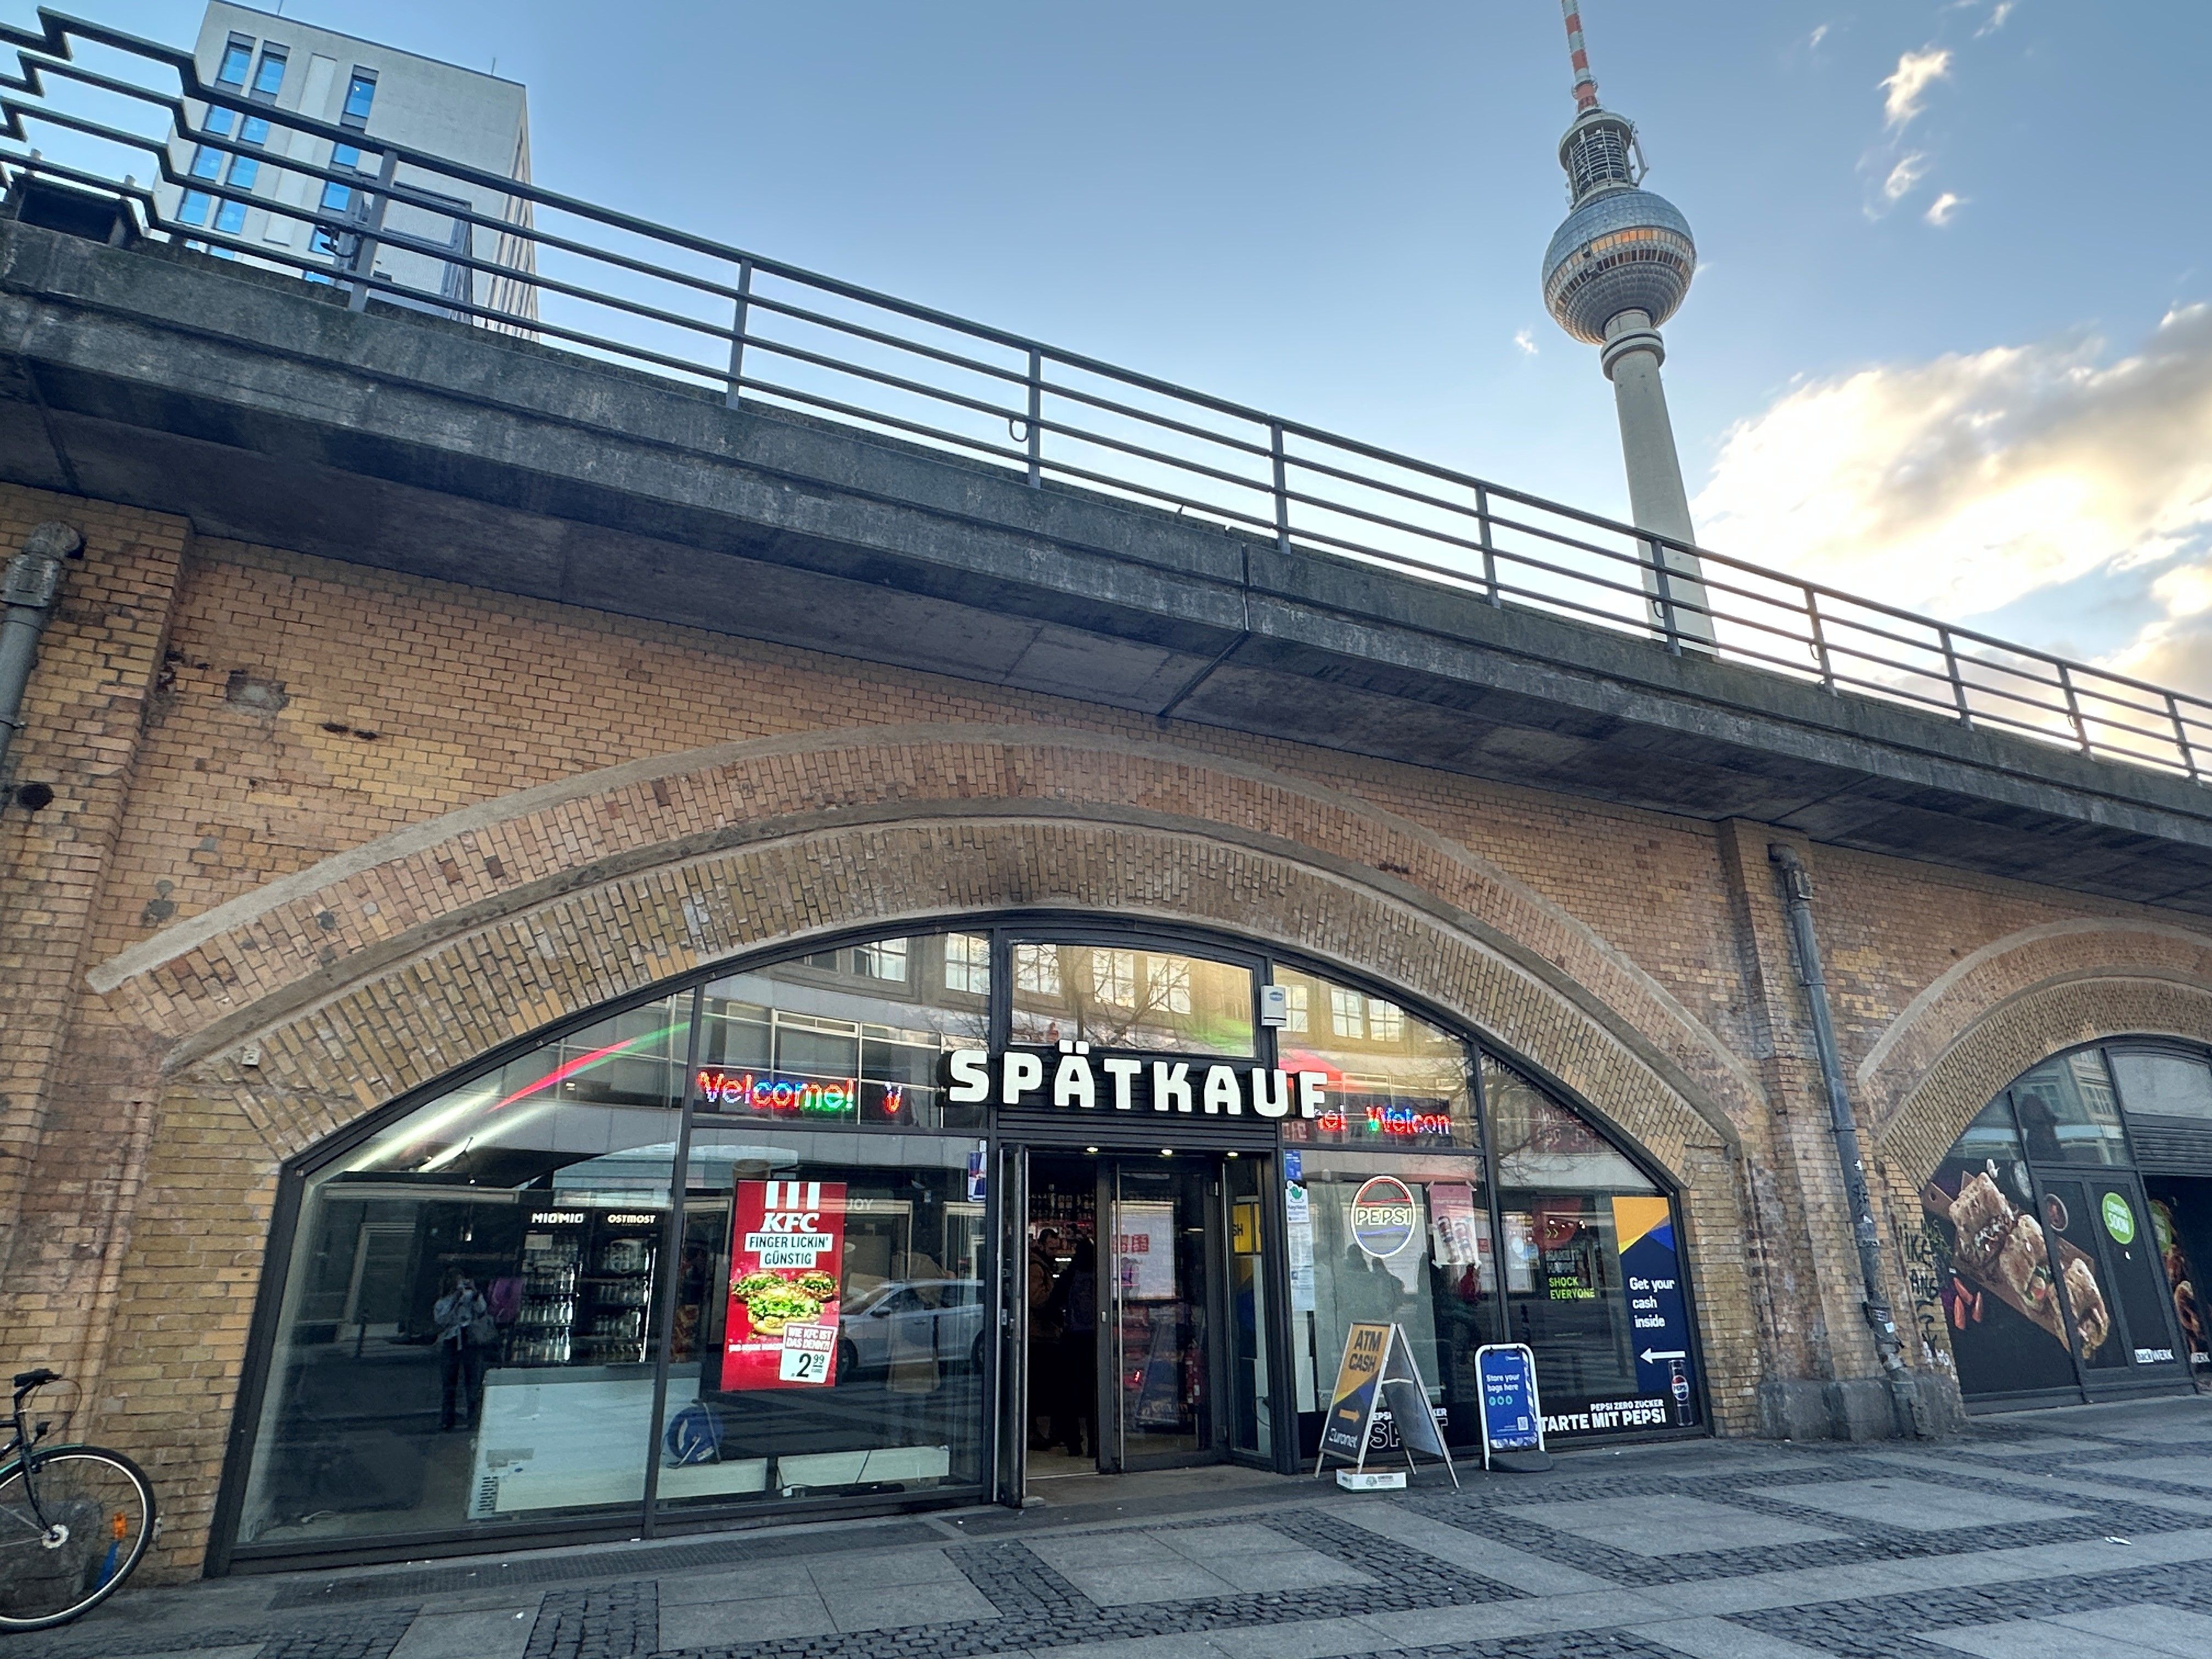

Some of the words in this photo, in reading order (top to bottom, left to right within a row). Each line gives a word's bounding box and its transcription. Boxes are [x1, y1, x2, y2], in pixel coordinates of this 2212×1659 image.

[949, 1039, 1329, 1119] SPÄTKAUF
[607, 1214, 656, 1224] OSTMOST
[759, 1212, 820, 1233] KFC
[1355, 1206, 1413, 1226] PEPSI
[749, 1236, 788, 1249] FINGER
[791, 1236, 829, 1249] LICKIN'
[764, 1250, 812, 1265] GÜNSTIG
[1548, 1276, 1579, 1287] SHOCK
[1629, 1276, 1650, 1290] Get
[1651, 1279, 1675, 1293] your
[1550, 1288, 1596, 1300] EVERYONE
[1632, 1295, 1658, 1309] cash
[1634, 1313, 1666, 1328] inside
[788, 1327, 803, 1338] WIE
[803, 1328, 819, 1339] KFC
[819, 1330, 833, 1340] IST
[786, 1337, 802, 1347] DAS
[1354, 1330, 1383, 1352] ATM
[795, 1352, 812, 1378] 2
[813, 1354, 825, 1365] 99
[1348, 1353, 1378, 1373] CASH
[1486, 1374, 1504, 1383] Store
[1504, 1374, 1520, 1383] your
[1487, 1384, 1503, 1393] bags
[1503, 1383, 1519, 1391] here
[1590, 1402, 1612, 1412] PEPSI
[1614, 1401, 1633, 1410] ZERO
[1634, 1399, 1664, 1409] ZUCKER
[1373, 1411, 1392, 1420] EPSI
[1541, 1413, 1590, 1432] TARTE
[1592, 1411, 1619, 1429] MIT
[1622, 1408, 1667, 1426] PEPSI
[1328, 1427, 1359, 1448] Euronet
